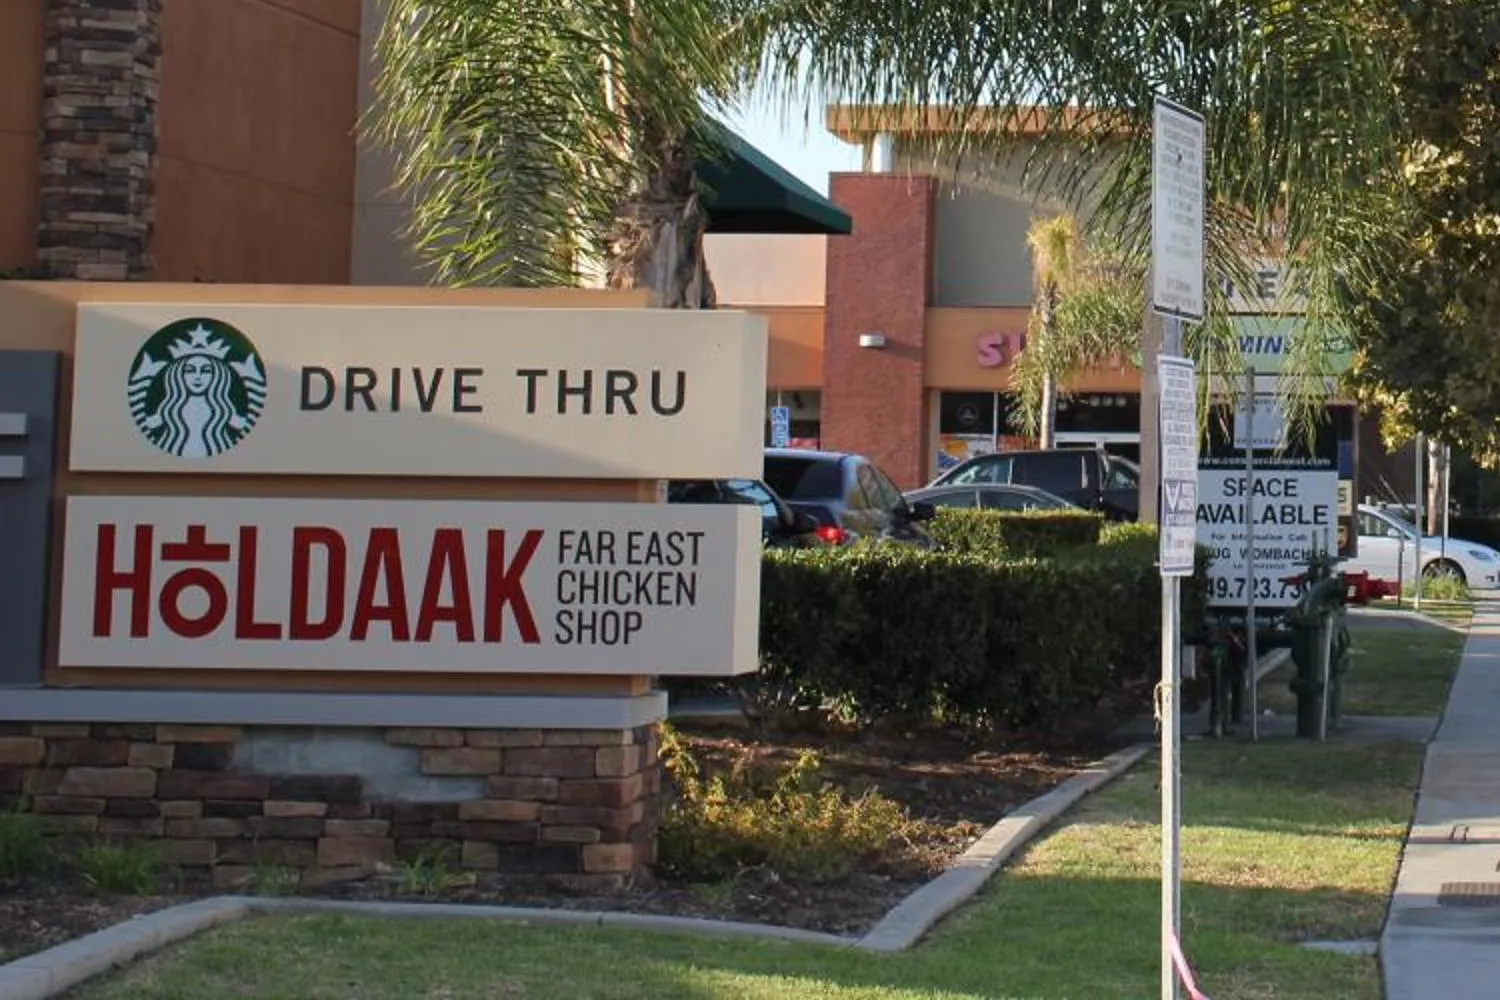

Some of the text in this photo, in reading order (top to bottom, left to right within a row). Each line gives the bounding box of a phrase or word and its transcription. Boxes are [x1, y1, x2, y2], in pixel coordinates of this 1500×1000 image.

[300, 365, 687, 416] DRIVE THRU
[1222, 477, 1299, 498] SPACE
[558, 530, 705, 566] FAR EAST
[556, 569, 697, 606] CHICKEN
[555, 609, 643, 645] SHOP
